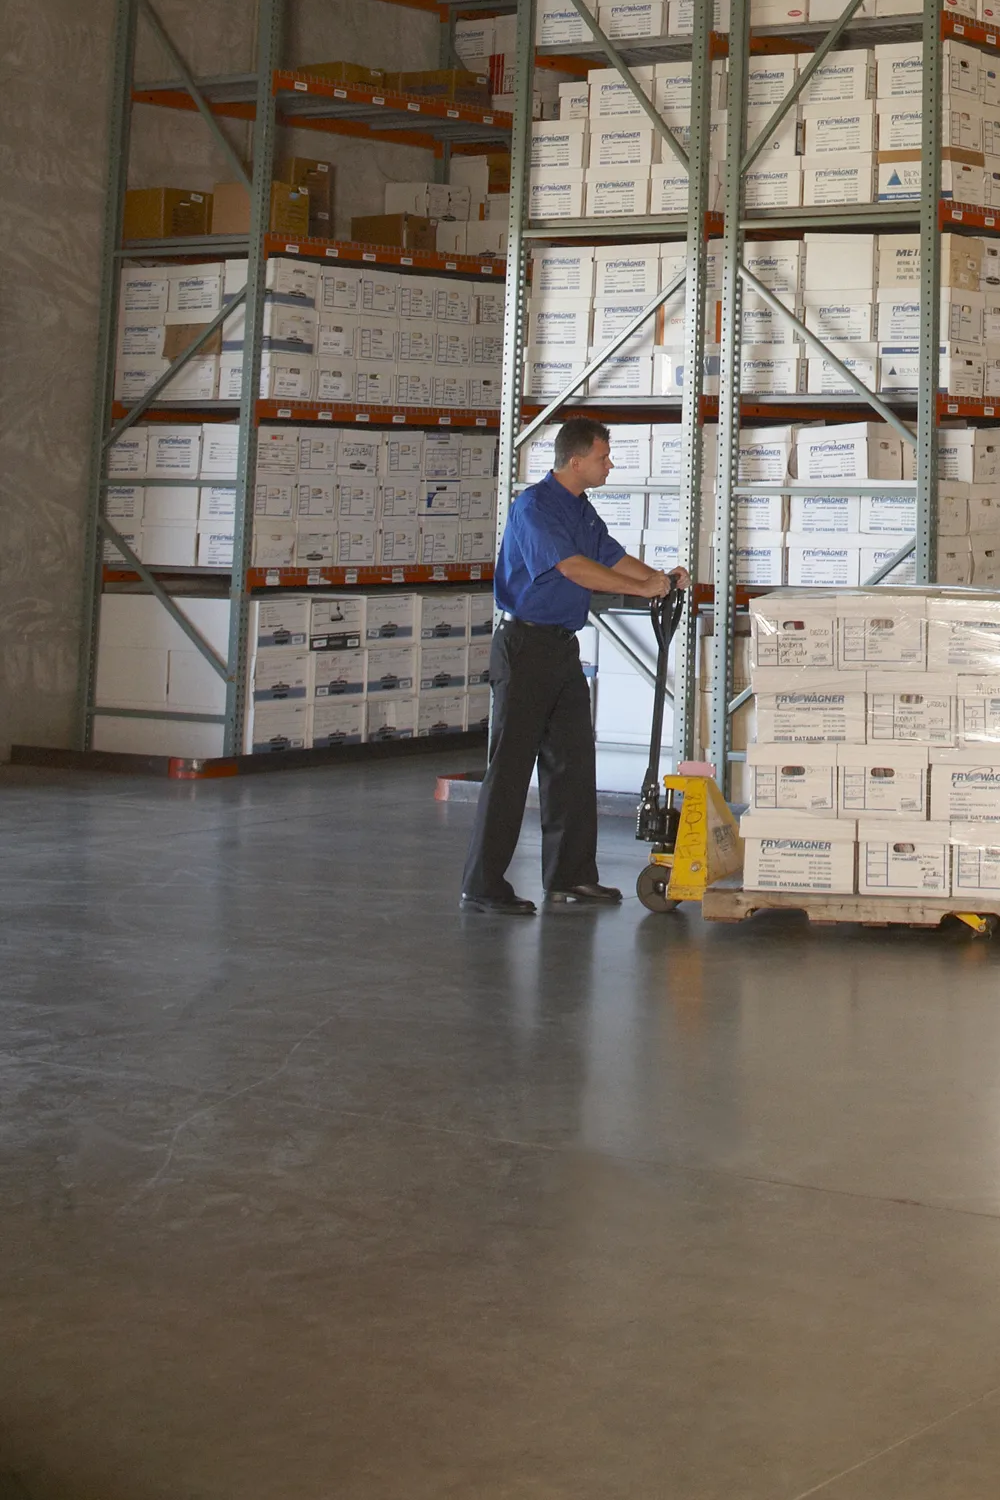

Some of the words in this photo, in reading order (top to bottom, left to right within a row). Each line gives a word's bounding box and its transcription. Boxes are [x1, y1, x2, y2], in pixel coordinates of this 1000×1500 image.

[828, 443, 855, 451] WAGNER
[754, 448, 781, 456] WAGNER
[775, 695, 792, 704] FRY
[802, 694, 845, 704] WAGNER
[951, 773, 970, 781] FRY
[761, 839, 781, 847] FRY
[790, 841, 831, 849] WAGNER
